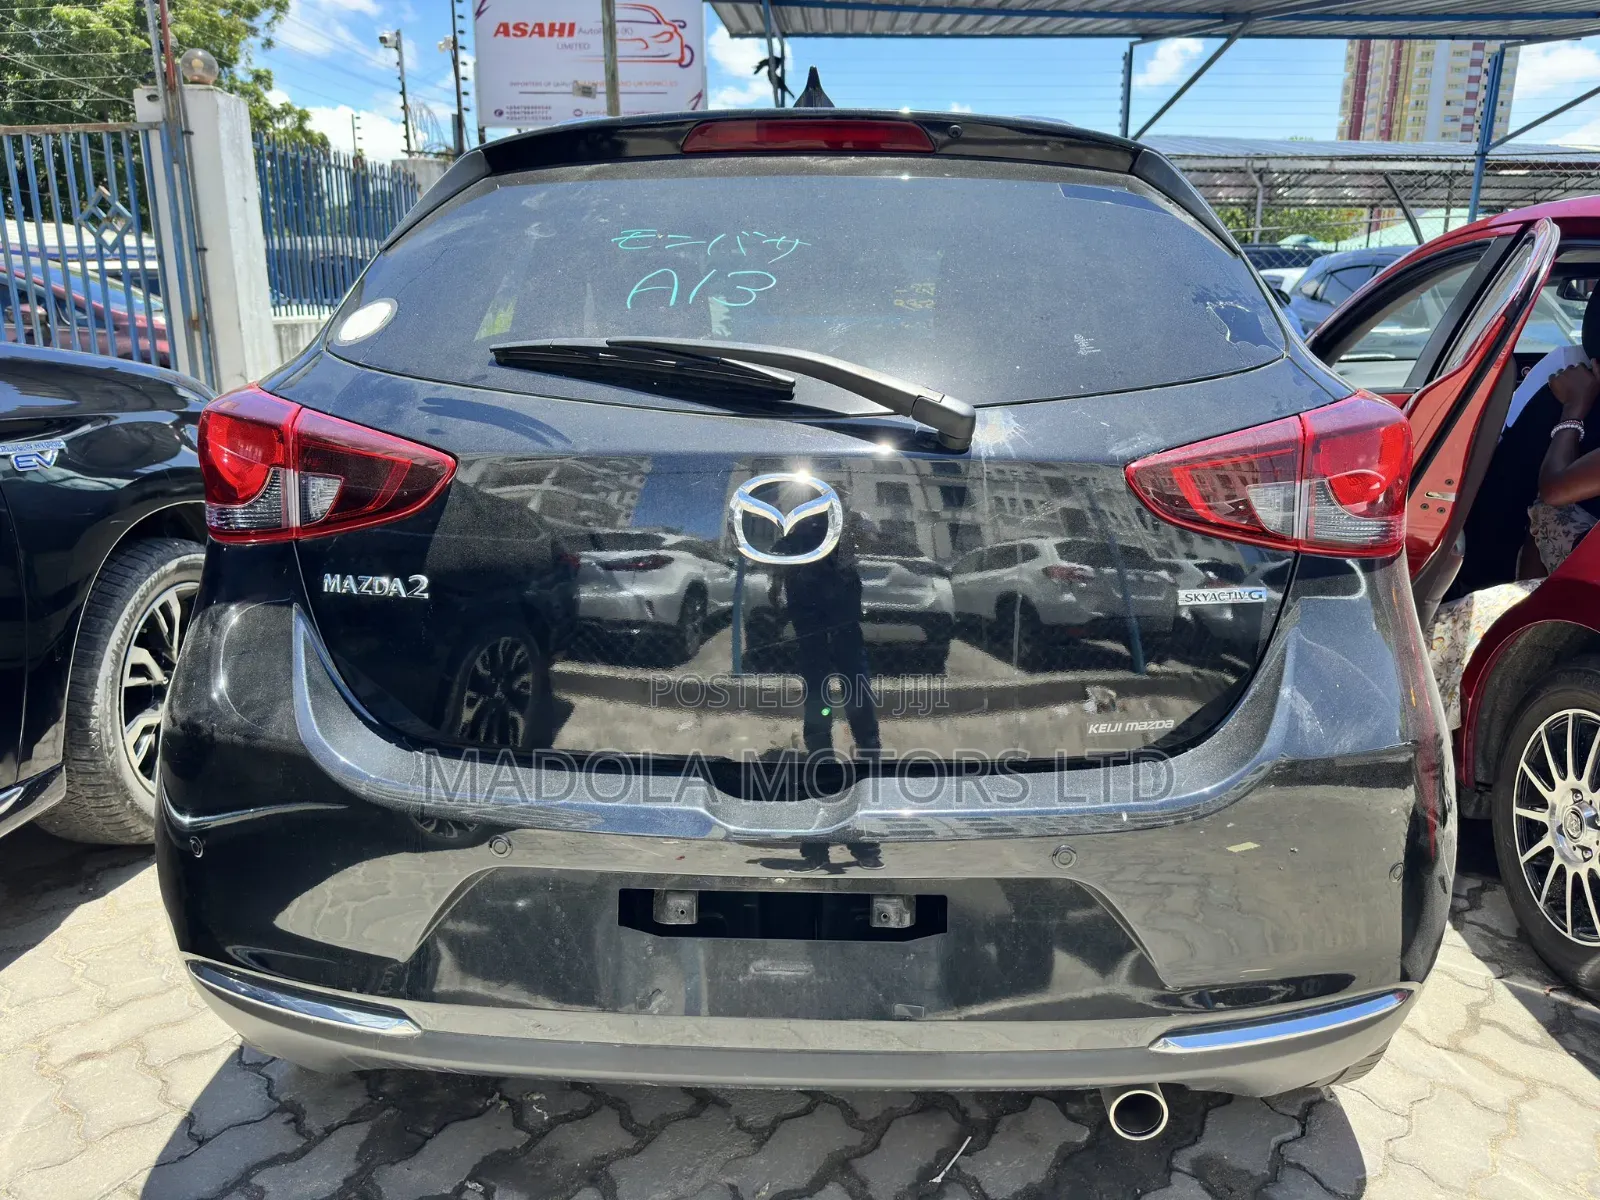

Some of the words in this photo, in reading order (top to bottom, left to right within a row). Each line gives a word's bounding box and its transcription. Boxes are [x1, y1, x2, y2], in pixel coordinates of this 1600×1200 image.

[493, 22, 576, 38] ASAHI
[11, 450, 59, 470] EV
[1088, 723, 1123, 734] KEIJI
